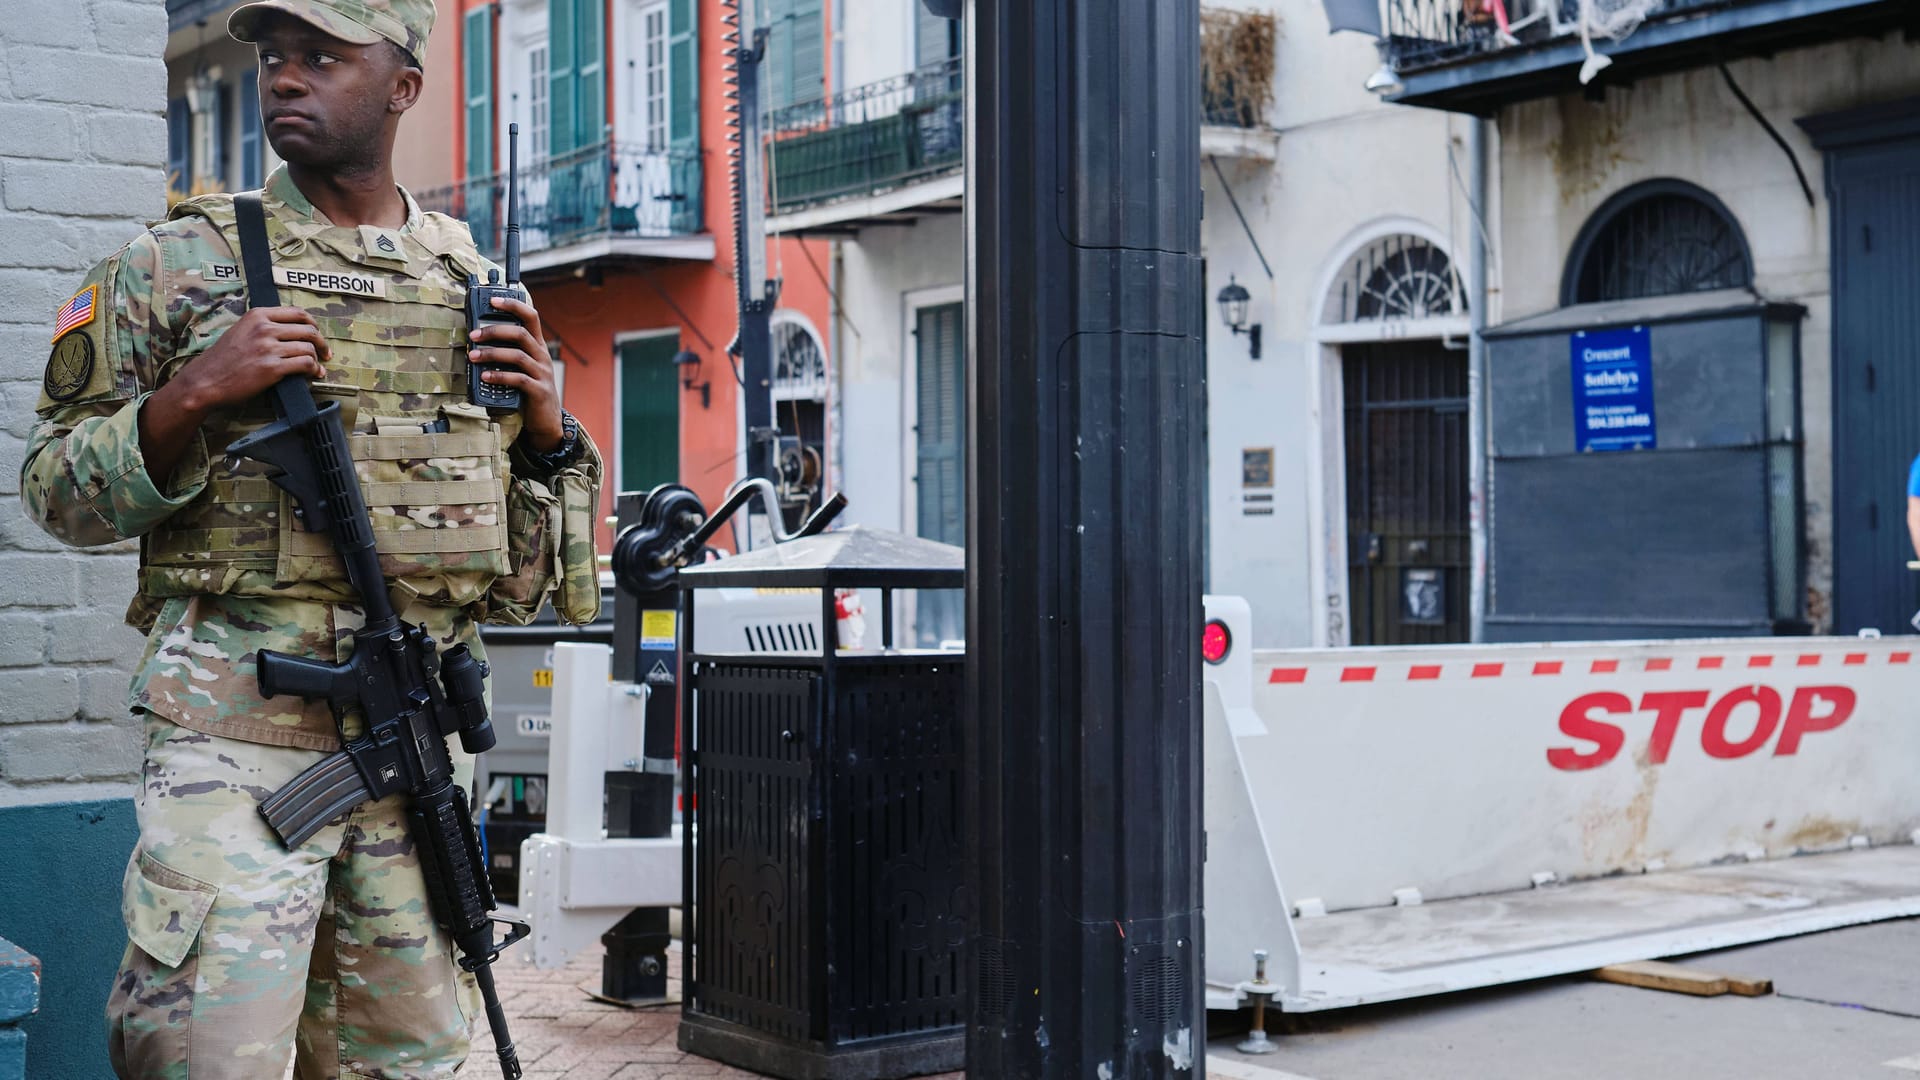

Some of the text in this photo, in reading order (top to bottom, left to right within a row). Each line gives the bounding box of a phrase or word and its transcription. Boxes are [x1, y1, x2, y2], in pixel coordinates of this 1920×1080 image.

[286, 271, 375, 293] EPPERSON
[1584, 346, 1630, 362] Crescent
[1584, 370, 1639, 388] Sotheby's
[535, 671, 553, 686] 11
[1546, 684, 1856, 772] STOP
